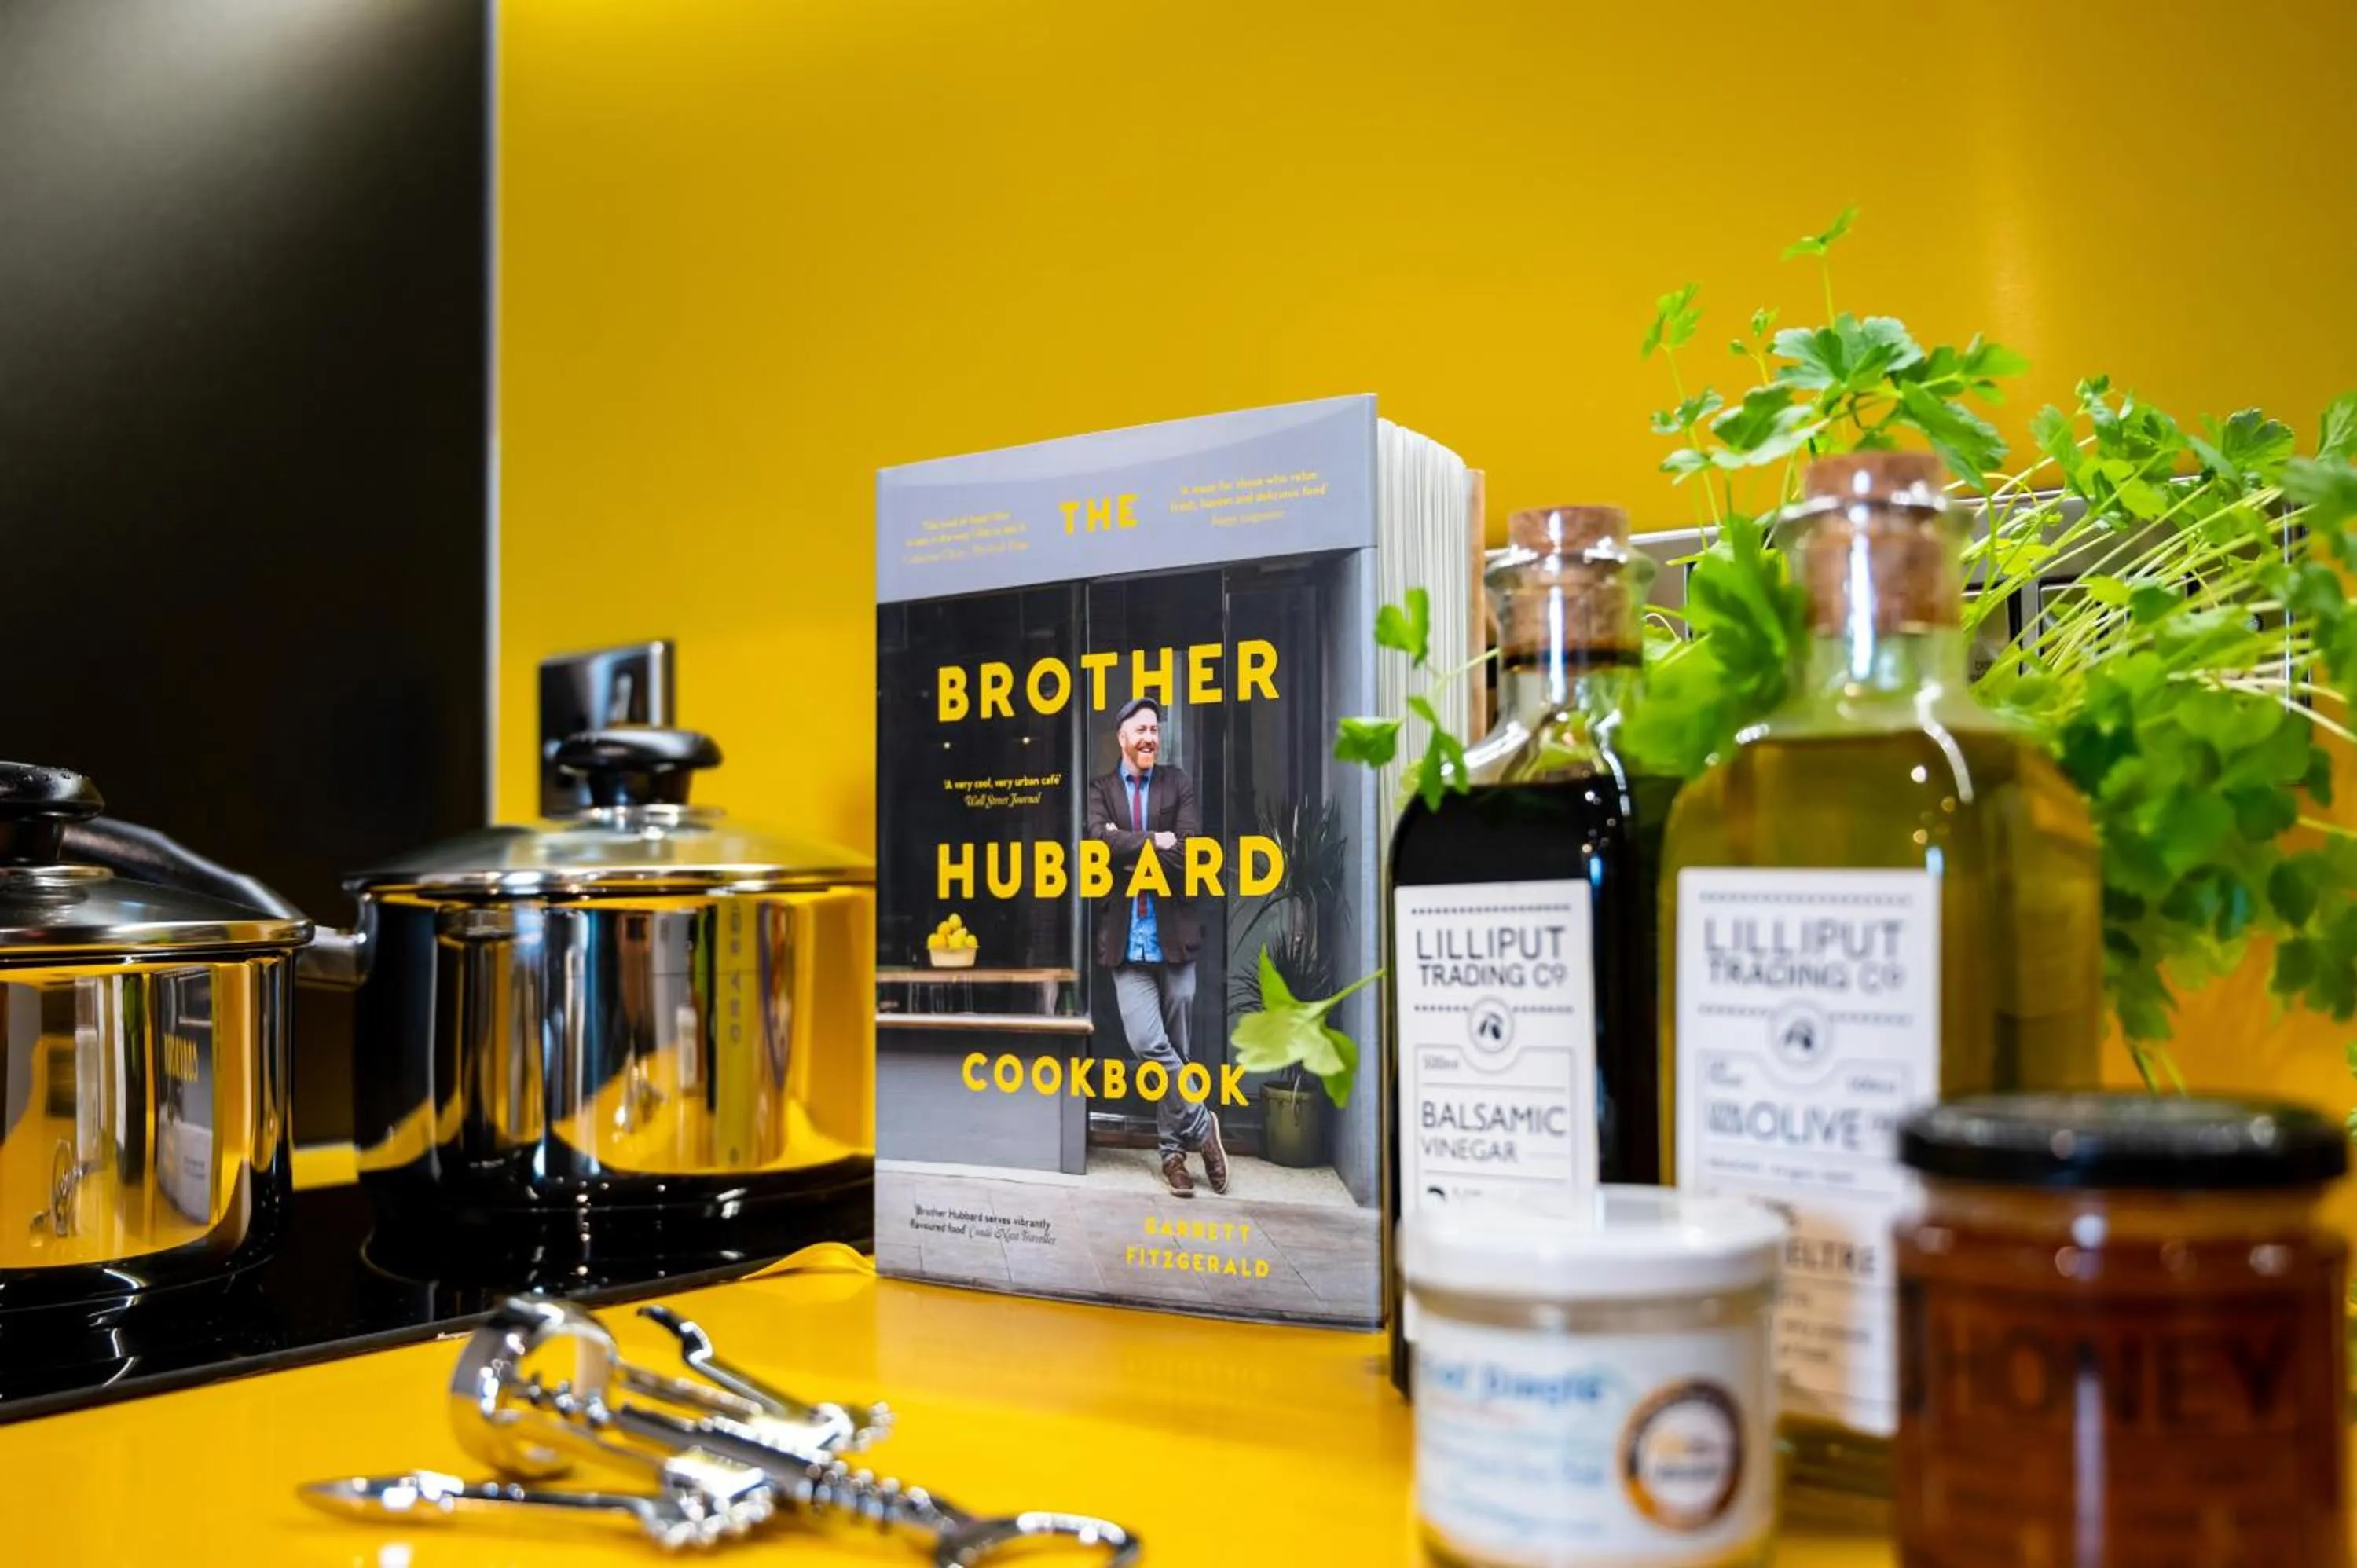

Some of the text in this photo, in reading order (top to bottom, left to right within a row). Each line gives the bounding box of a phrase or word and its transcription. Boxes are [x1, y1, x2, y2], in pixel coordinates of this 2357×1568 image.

[1057, 493, 1140, 536] THE
[937, 639, 1280, 722] BROTHER
[995, 779, 1013, 790] very
[1014, 775, 1039, 787] urban
[937, 835, 1285, 900] HUBBARD
[1416, 925, 1566, 961] LILLIPUT
[1703, 917, 1904, 961] LILLIPUT
[1419, 962, 1526, 987] TRADING
[961, 1051, 1250, 1107] COOKBOOK
[1421, 1101, 1567, 1138] BALSAMIC
[1420, 1137, 1518, 1163] VINEGAR
[948, 1206, 983, 1222] Hubbard
[984, 1214, 1011, 1225] serves
[1013, 1216, 1051, 1231] vibrantly
[1125, 1244, 1270, 1278] FITZGERALD
